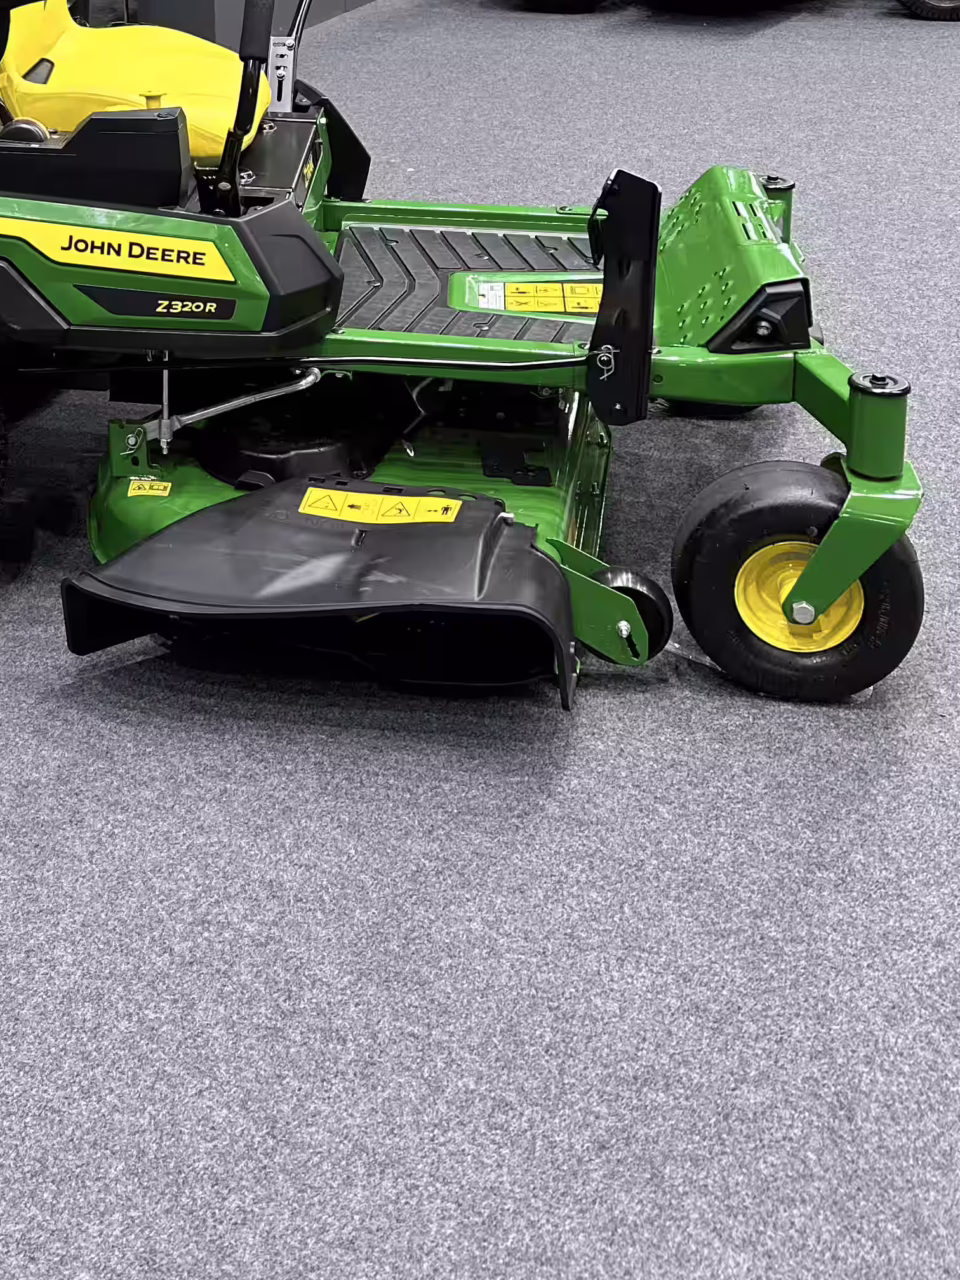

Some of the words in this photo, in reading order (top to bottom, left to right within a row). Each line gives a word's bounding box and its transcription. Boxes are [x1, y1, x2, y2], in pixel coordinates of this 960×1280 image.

[61, 235, 122, 257] JOHN
[128, 241, 207, 267] DEERE
[155, 300, 217, 314] Z320R
